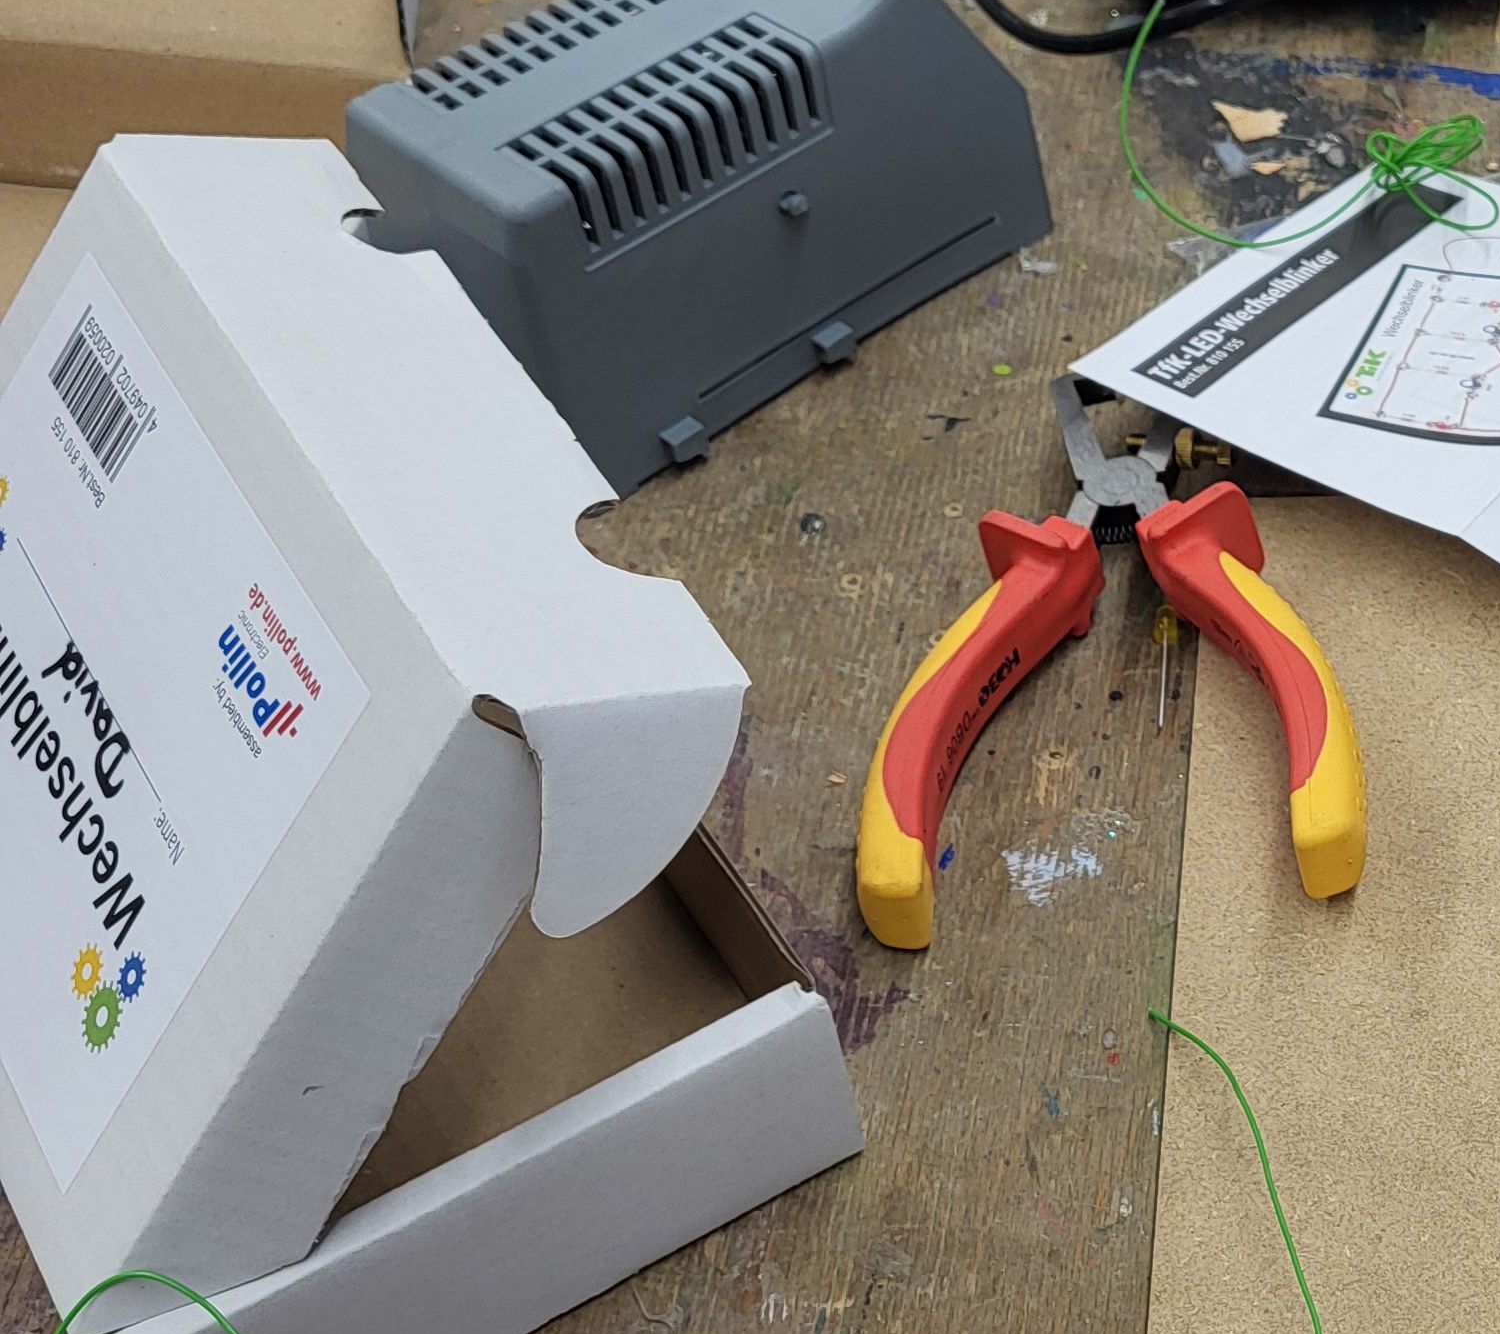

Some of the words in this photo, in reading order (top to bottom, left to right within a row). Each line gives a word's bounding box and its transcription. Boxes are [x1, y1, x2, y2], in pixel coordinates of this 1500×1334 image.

[1148, 249, 1341, 380] TfK-LED-Wechselblinker
[47, 415, 70, 443] 155
[60, 437, 83, 465] 810
[235, 609, 270, 660] Electronic
[246, 582, 320, 701] www.pollin.de
[209, 676, 229, 702] by:
[218, 624, 280, 728] Pollin
[41, 641, 131, 798] David
[220, 697, 263, 758] assembled
[153, 806, 186, 866] Name:
